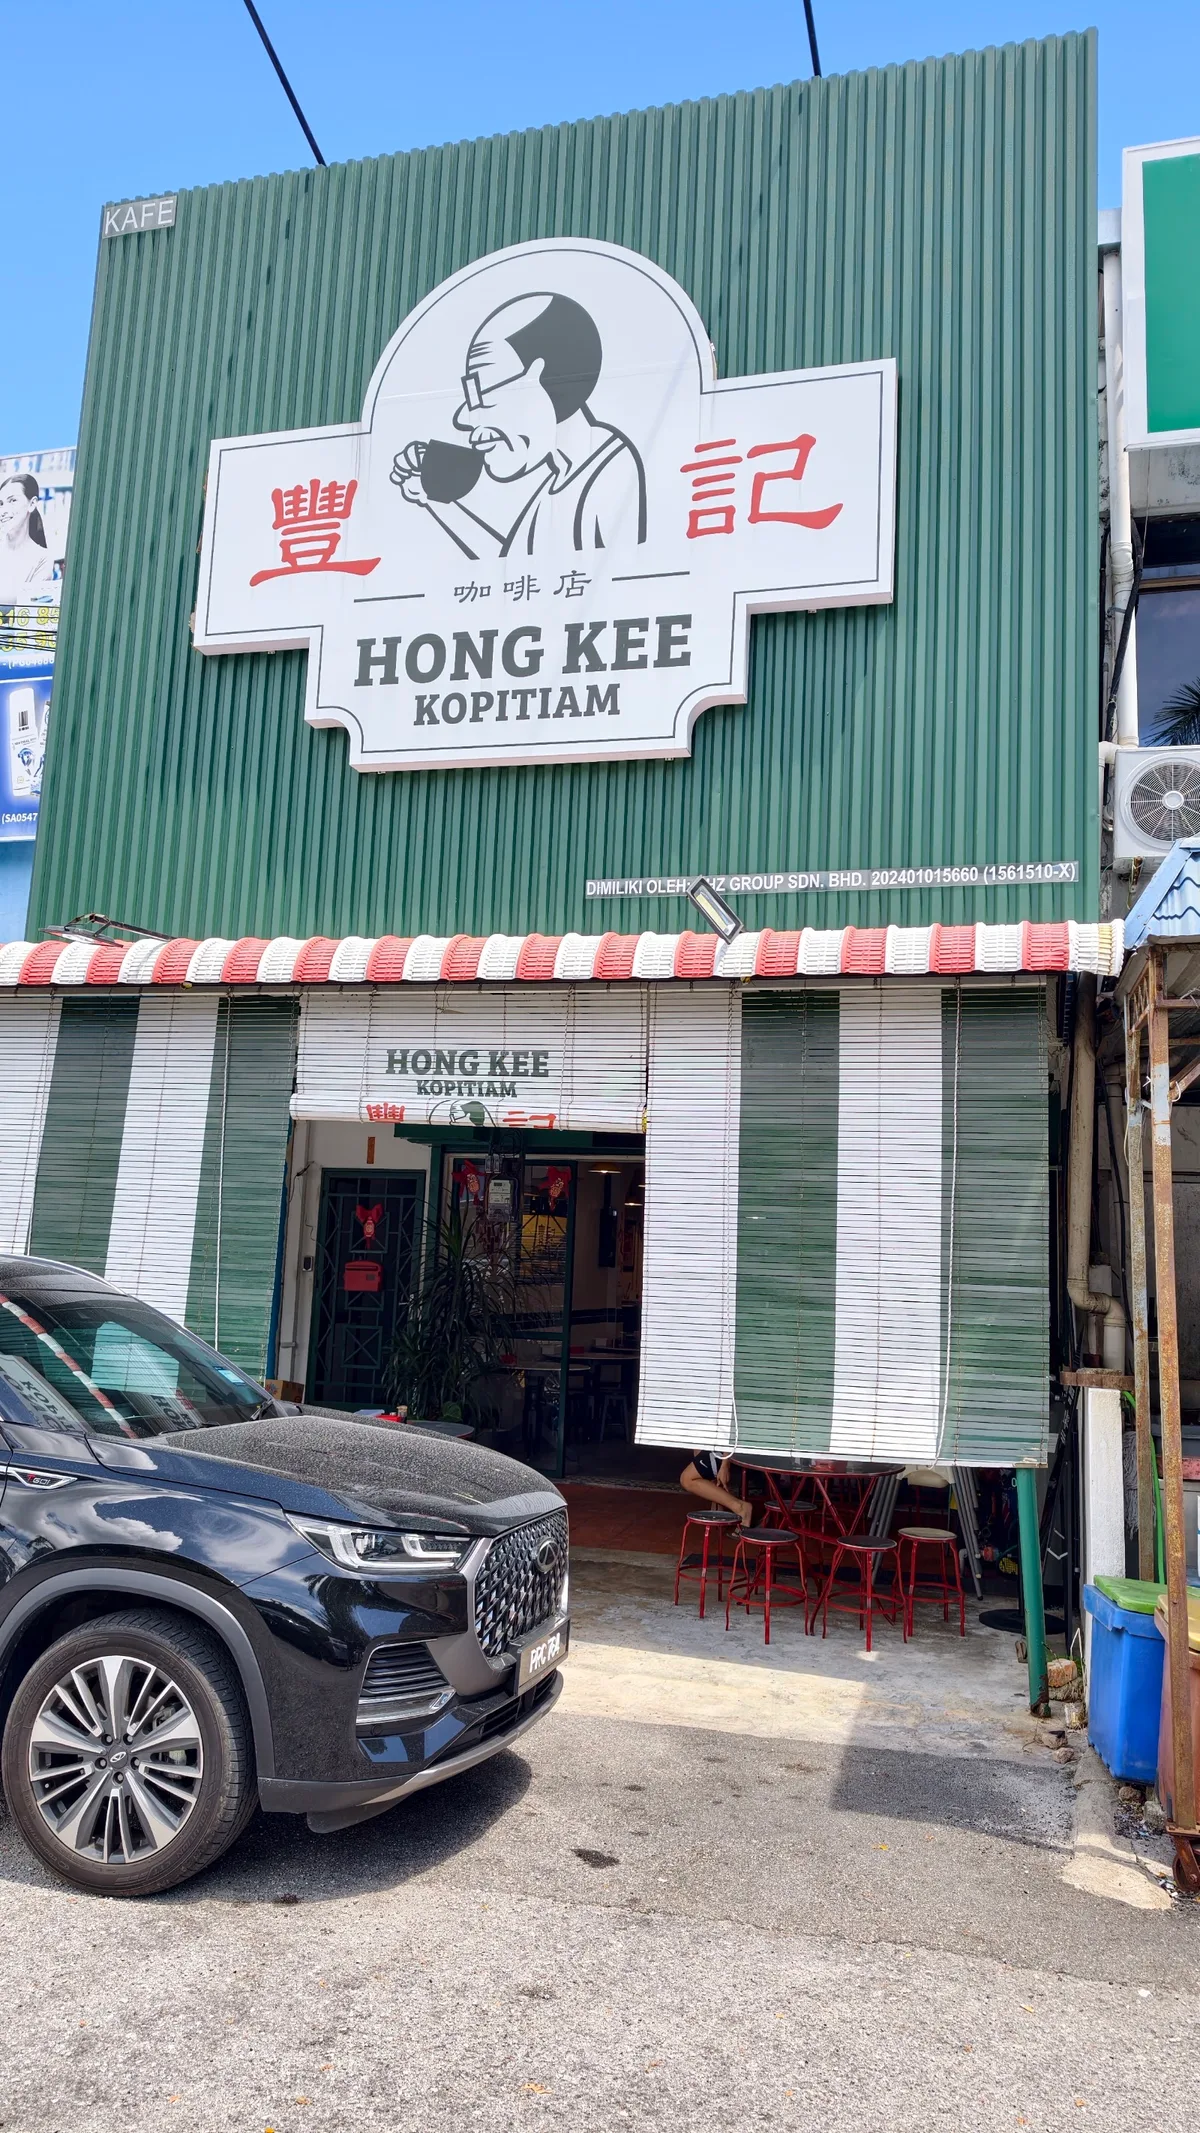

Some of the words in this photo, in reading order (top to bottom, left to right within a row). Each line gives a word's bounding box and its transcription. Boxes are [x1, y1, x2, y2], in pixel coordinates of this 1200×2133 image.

[104, 200, 174, 235] KAFE
[249, 478, 382, 587] 豐
[680, 433, 843, 539] 記
[453, 569, 593, 604] 咖啡店
[0, 608, 29, 627] 16
[353, 625, 545, 687] HONG
[562, 613, 693, 674] KEE
[413, 683, 621, 726] KOPITIAM
[2, 812, 38, 824] (SA0547
[586, 880, 643, 895] DIMILIKI
[729, 875, 784, 891] GROUP
[788, 873, 824, 889] SDN.
[828, 872, 867, 888] BHD.
[871, 866, 979, 886] 202401015660
[983, 862, 1076, 885] (1561510-X)
[386, 1049, 480, 1077] HONG
[487, 1050, 550, 1078] KEE
[416, 1080, 518, 1098] KOPITIAM
